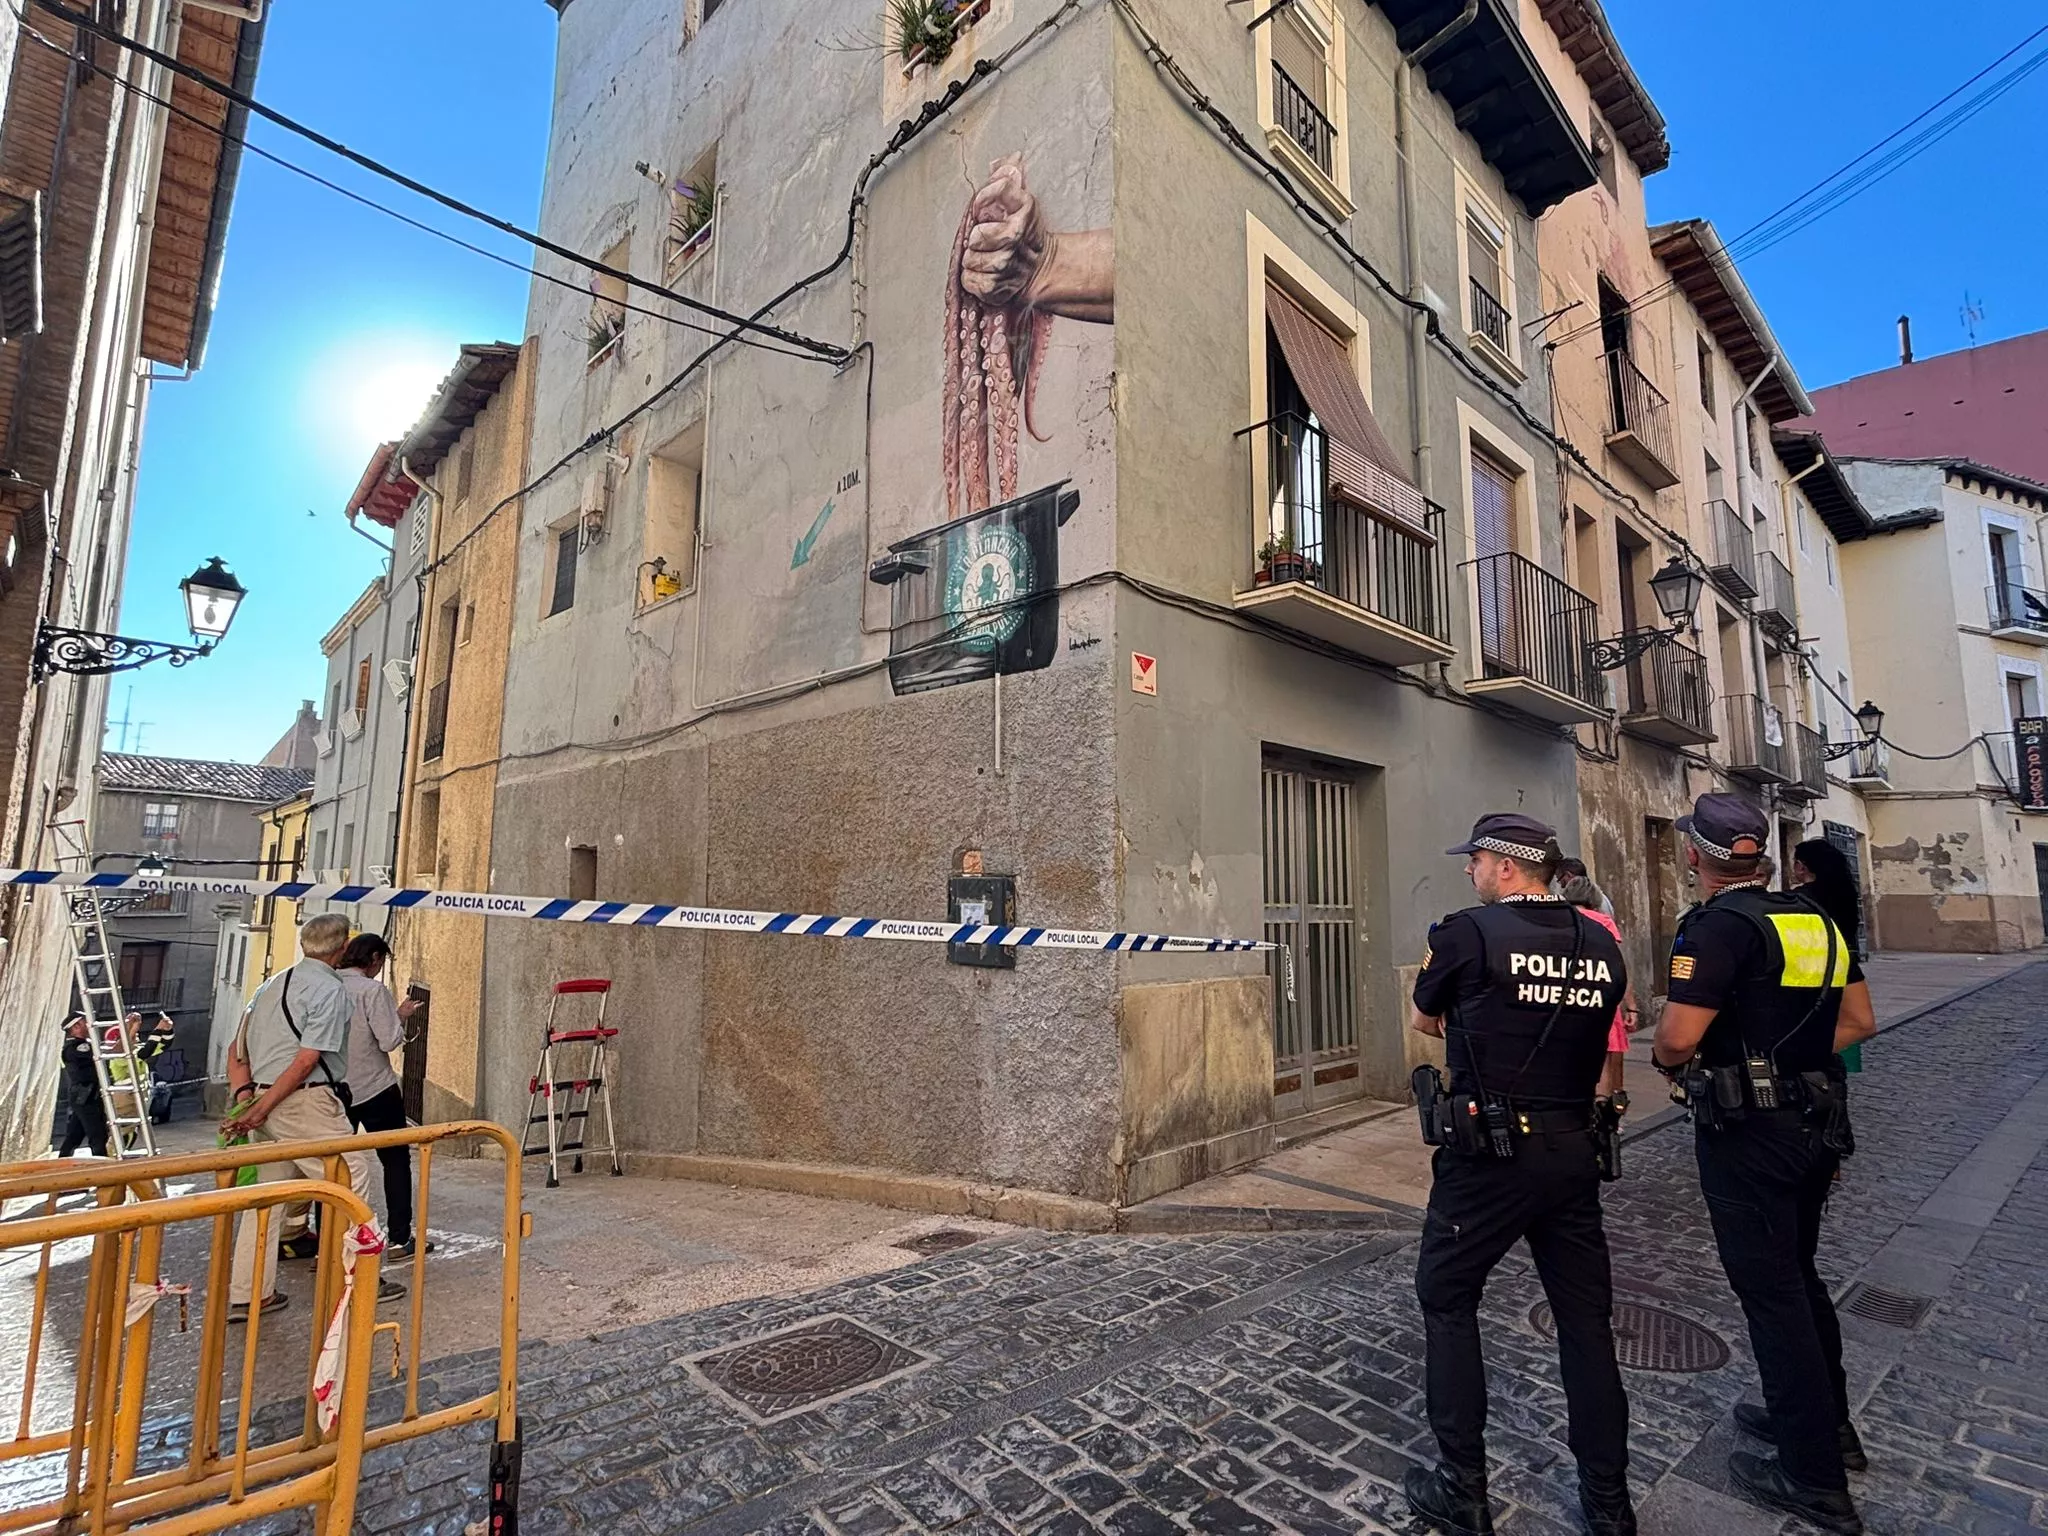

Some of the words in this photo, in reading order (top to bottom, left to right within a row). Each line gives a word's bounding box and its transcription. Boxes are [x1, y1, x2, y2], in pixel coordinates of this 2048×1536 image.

[2019, 721, 2043, 734] BAR
[138, 880, 198, 892] POLICIA
[203, 883, 251, 894] LOCAL
[435, 895, 484, 909] POLICIA
[487, 899, 526, 911] LOCAL
[1526, 894, 1559, 902] POLICIA
[680, 911, 720, 923] POLICIA
[723, 914, 756, 925] LOCAL
[881, 924, 915, 935] POLICIA
[917, 926, 944, 936] LOCAL
[1047, 933, 1075, 943] POLICIA
[1077, 935, 1099, 944] LOCAL
[1510, 953, 1612, 983] POLICIA
[1518, 983, 1603, 1008] HUESCA
